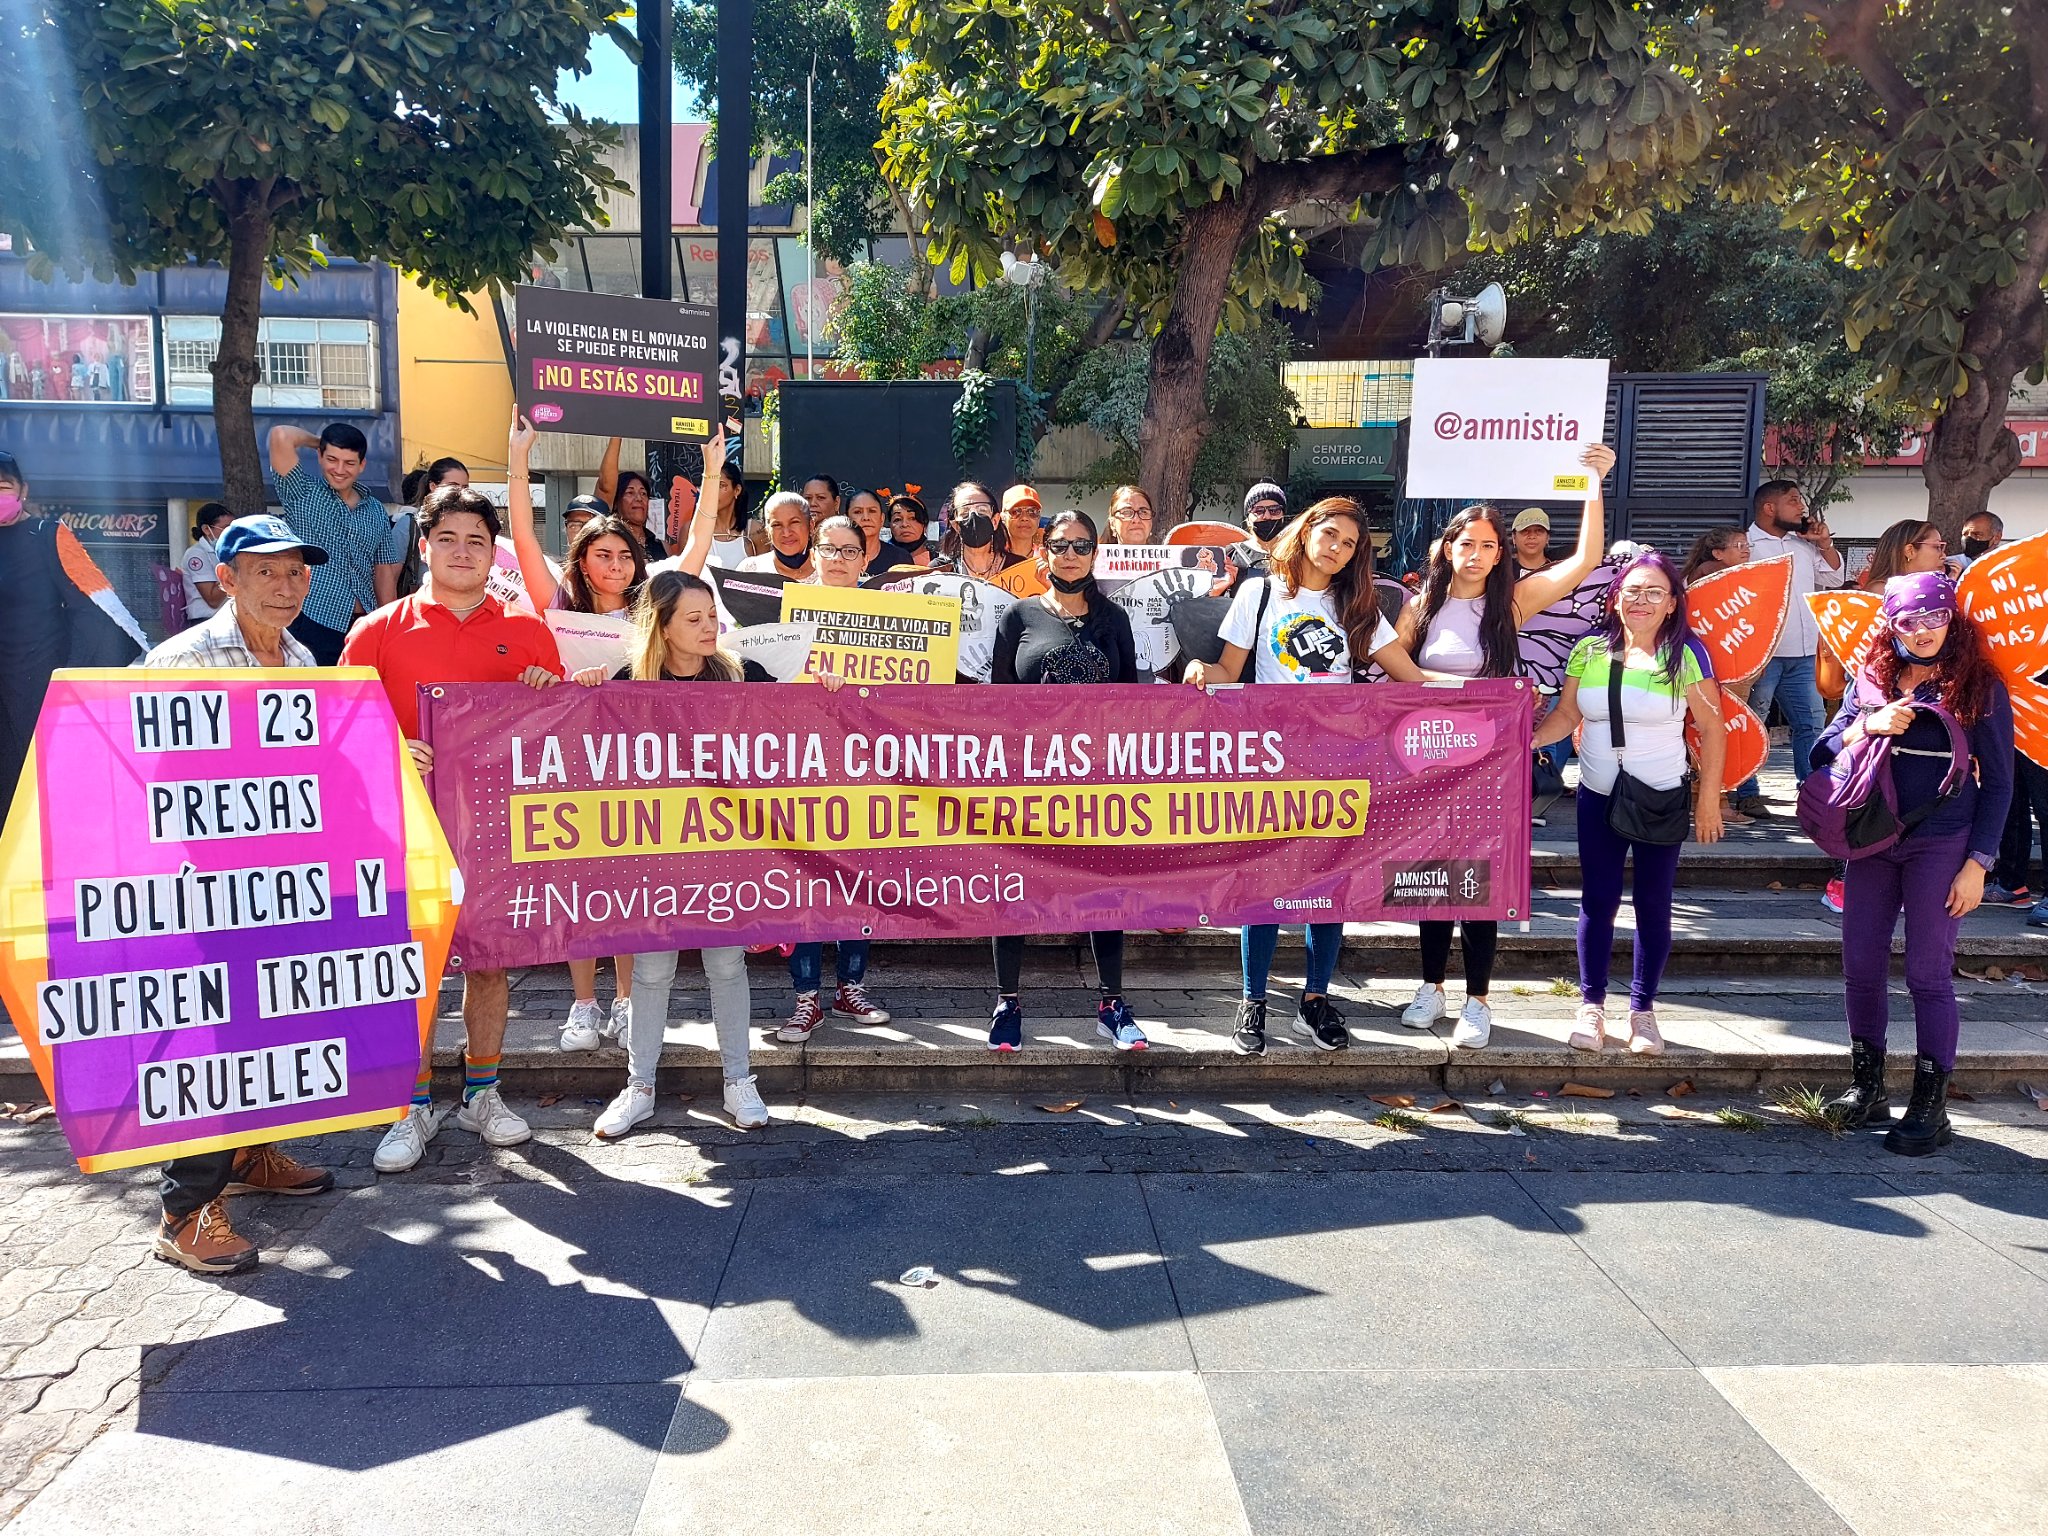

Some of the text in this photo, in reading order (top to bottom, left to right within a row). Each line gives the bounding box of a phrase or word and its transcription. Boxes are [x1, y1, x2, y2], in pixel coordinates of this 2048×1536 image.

[690, 243, 770, 263] Reos
[679, 306, 711, 318] @amnistia
[526, 318, 708, 349] LA VIOLENCIA EN EL NOVIAZGO
[557, 338, 679, 363] SE PUEDE PREVENIR
[538, 364, 699, 399] ¡NO ESTÁS SOLA!
[1434, 411, 1580, 441] @amnistia
[1311, 455, 1385, 465] COMERCIAL
[1312, 444, 1362, 454] CENTRO
[672, 509, 680, 543] WARRANT
[1106, 548, 1120, 558] NO
[1123, 548, 1138, 558] ME
[1000, 575, 1026, 593] NO
[1714, 585, 1758, 620] UNA
[1820, 598, 1842, 629] NO
[1973, 604, 1998, 623] UN
[792, 609, 810, 624] EN
[811, 611, 881, 630] VENEZUELA
[883, 617, 898, 631] LA
[901, 618, 930, 633] VIDA
[933, 620, 950, 636] DE
[1719, 617, 1756, 655] MAS
[1837, 617, 1859, 643] AL
[1986, 619, 2036, 650] MÁS
[813, 628, 925, 651] LAS MUJERES ESTÁ
[1846, 605, 1888, 673] MALTRAT
[804, 650, 931, 685] EN RIESGO
[135, 693, 315, 749] HAY 23
[1420, 719, 1455, 735] RED
[1421, 733, 1478, 750] MUJERES
[511, 730, 1286, 786] LA VIOLENCIA CONTRA LAS MUJERES
[153, 778, 318, 838] PRESAS
[523, 788, 1361, 853] ES UN ASUNTO DE DERECHOS HUMANOS
[1394, 867, 1450, 887] AMNISTÍA
[80, 863, 382, 938] POLÍTICAS Y
[507, 866, 1026, 929] #NoviazgoSinViolencia
[1273, 896, 1333, 910] @amnistia
[1393, 887, 1450, 898] INTERNACIONAL
[42, 945, 422, 1040] SUFREN TRATOS
[142, 1043, 343, 1121] CRUELES
